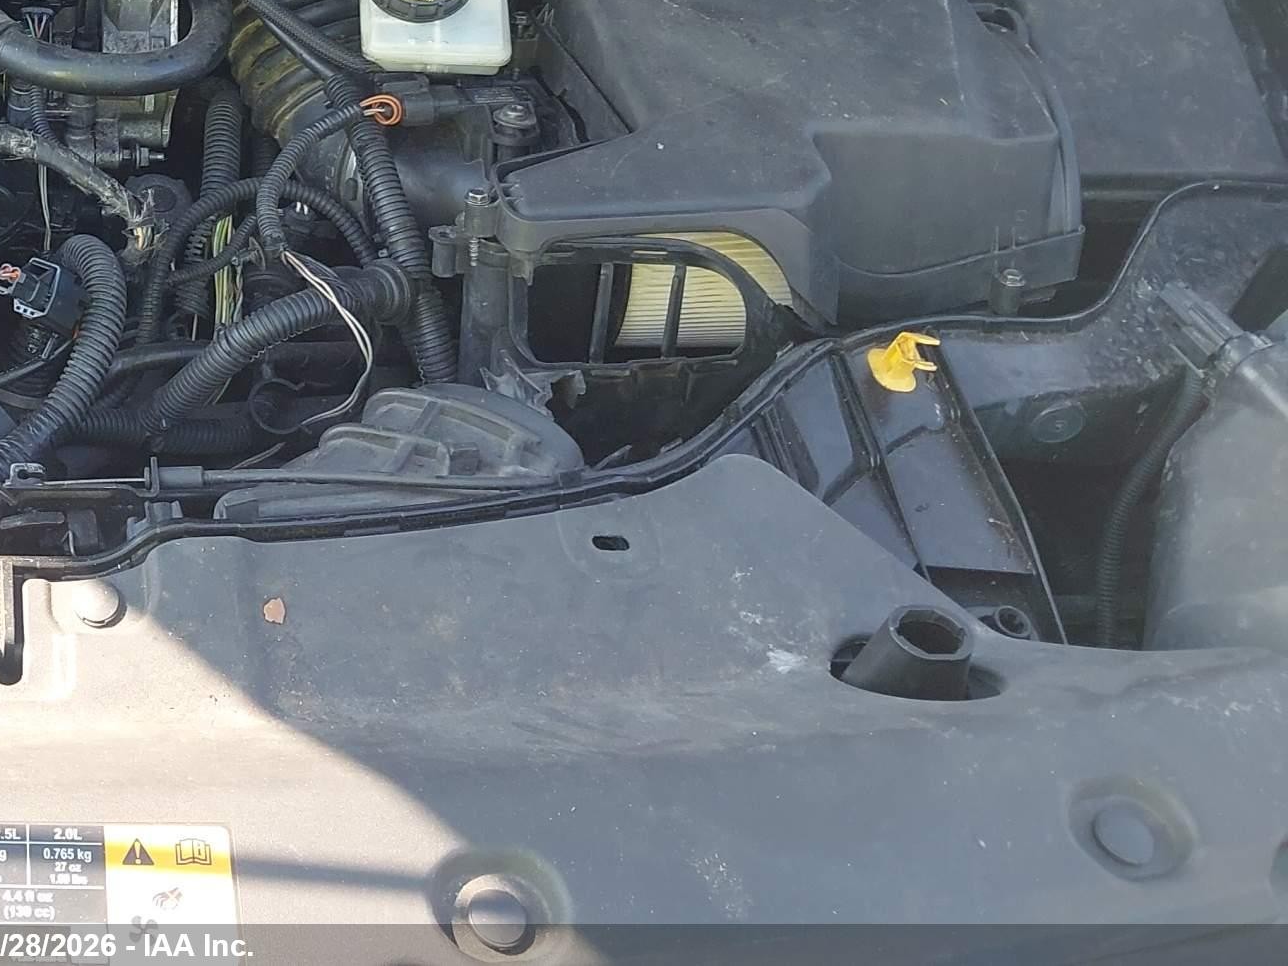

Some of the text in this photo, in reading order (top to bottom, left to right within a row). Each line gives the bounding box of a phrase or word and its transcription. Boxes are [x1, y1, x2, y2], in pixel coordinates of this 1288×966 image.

[53, 827, 83, 840] 2.0L
[43, 848, 92, 863] 0.765 kg
[54, 862, 82, 873] 27 oz
[37, 892, 54, 903] oz
